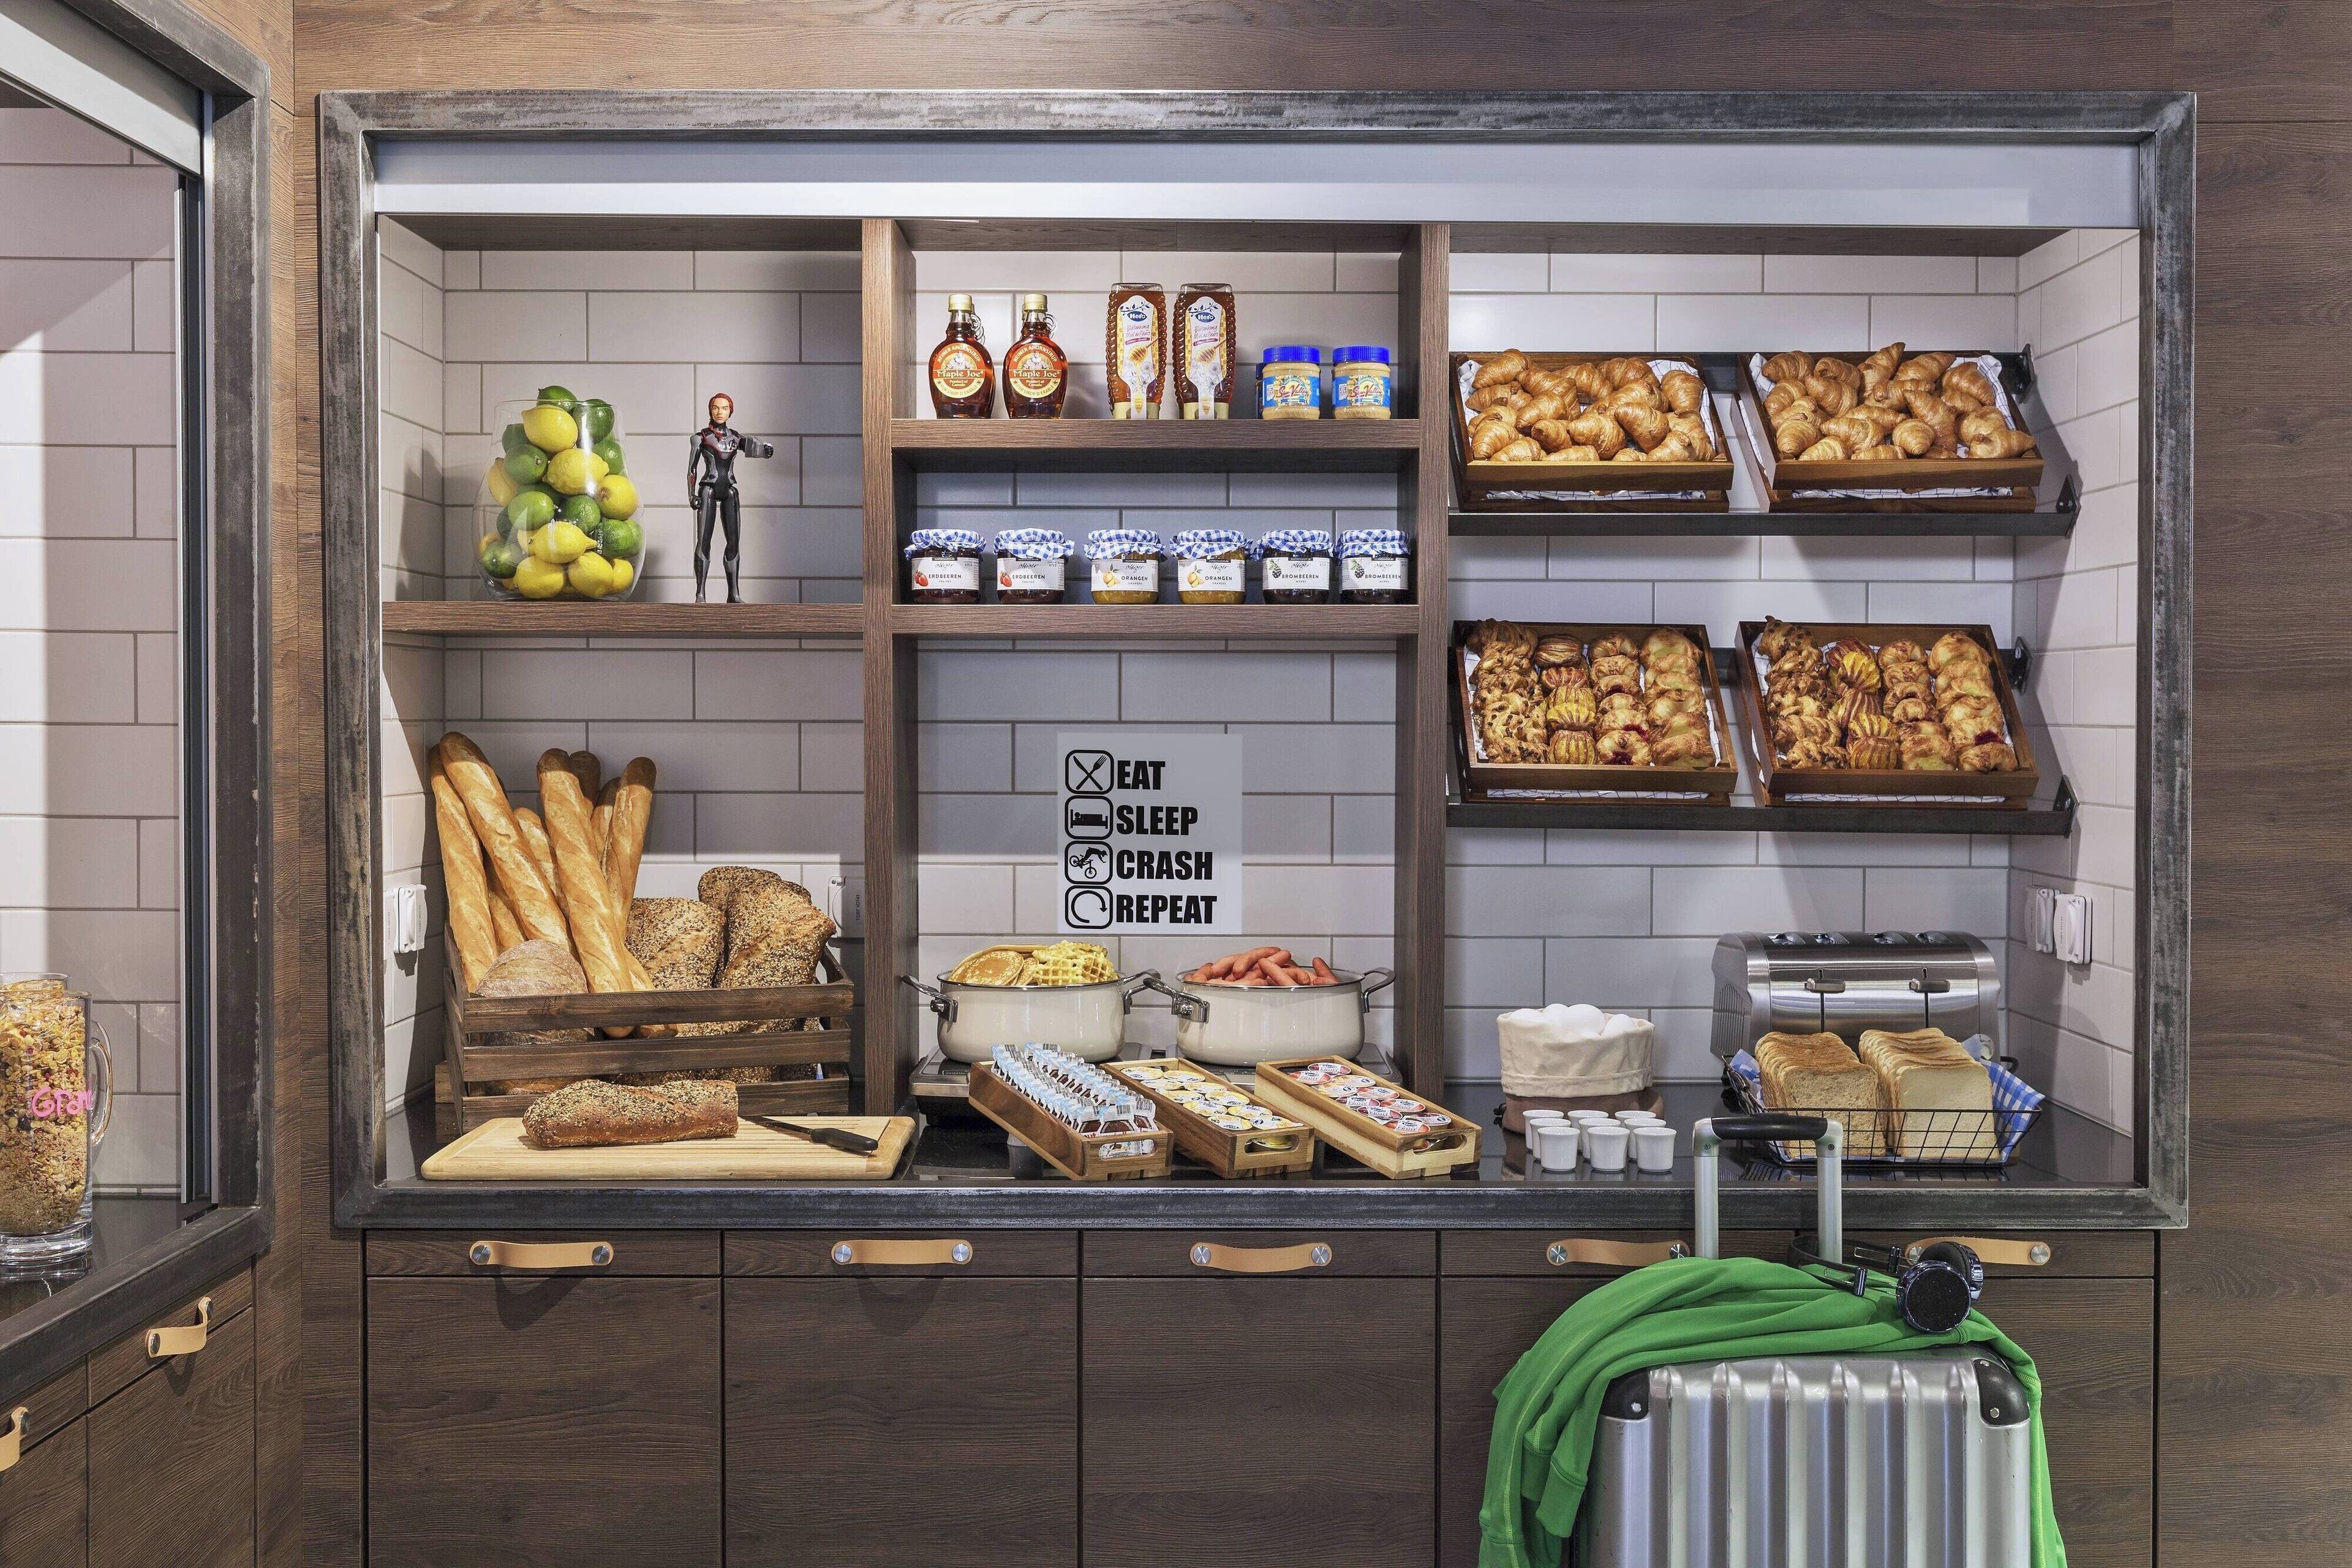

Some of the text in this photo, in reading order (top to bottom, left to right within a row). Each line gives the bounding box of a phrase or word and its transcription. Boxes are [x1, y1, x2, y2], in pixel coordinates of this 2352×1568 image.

[937, 345, 981, 363] REINER AHORNSIRUP
[1013, 344, 1057, 363] REINER AHORNSIRUP
[937, 370, 964, 379] Maple
[1012, 370, 1041, 379] Maple
[1289, 382, 1309, 397] Valley
[1363, 384, 1383, 397] Valley
[1117, 760, 1166, 790] EAT
[1116, 805, 1198, 835] SLEEP
[1116, 850, 1213, 880] CRASH
[1116, 894, 1217, 924] REPEAT
